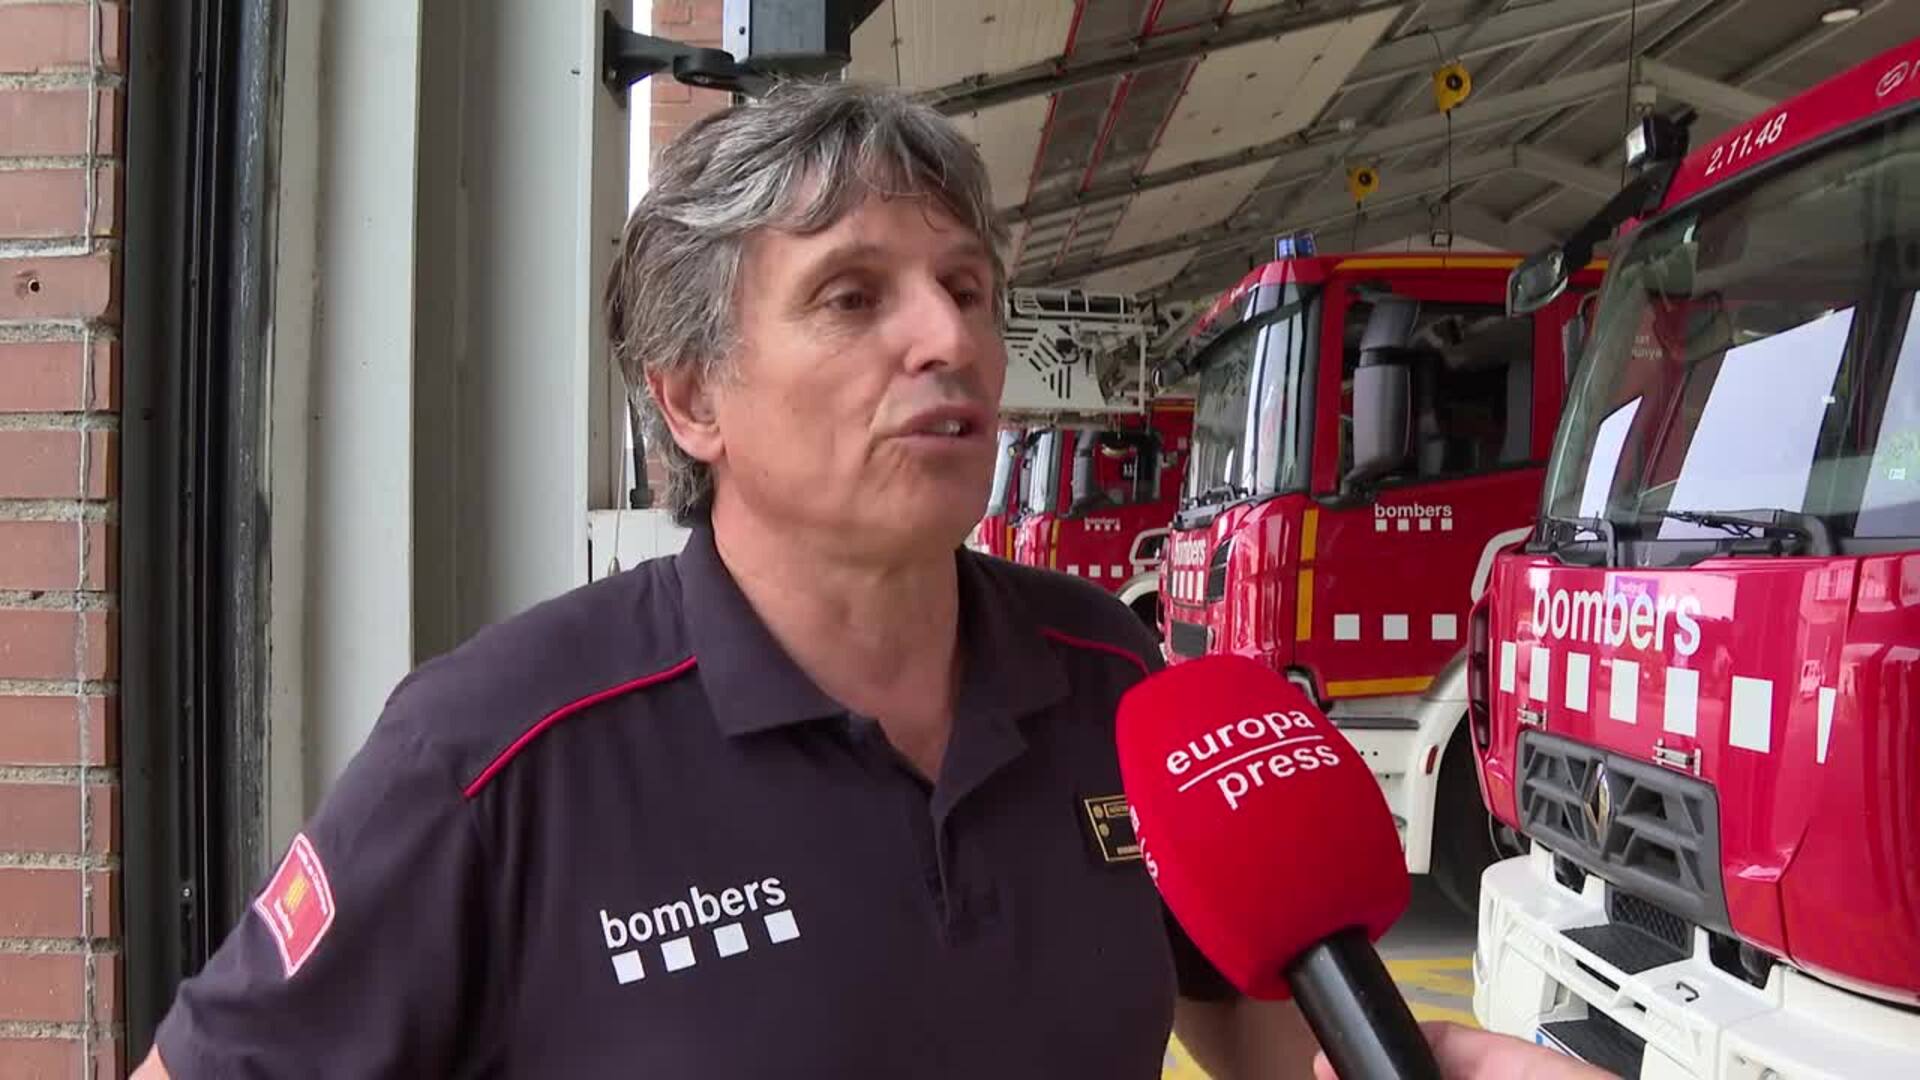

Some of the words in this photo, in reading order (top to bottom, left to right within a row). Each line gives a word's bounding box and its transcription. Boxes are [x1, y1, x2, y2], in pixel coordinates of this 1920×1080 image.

[1705, 113, 1787, 176] 2.11.48
[1374, 502, 1452, 517] bombers
[1532, 578, 1701, 656] bombers
[1166, 709, 1316, 775] europa
[1217, 743, 1340, 810] press
[599, 877, 787, 949] bombers
